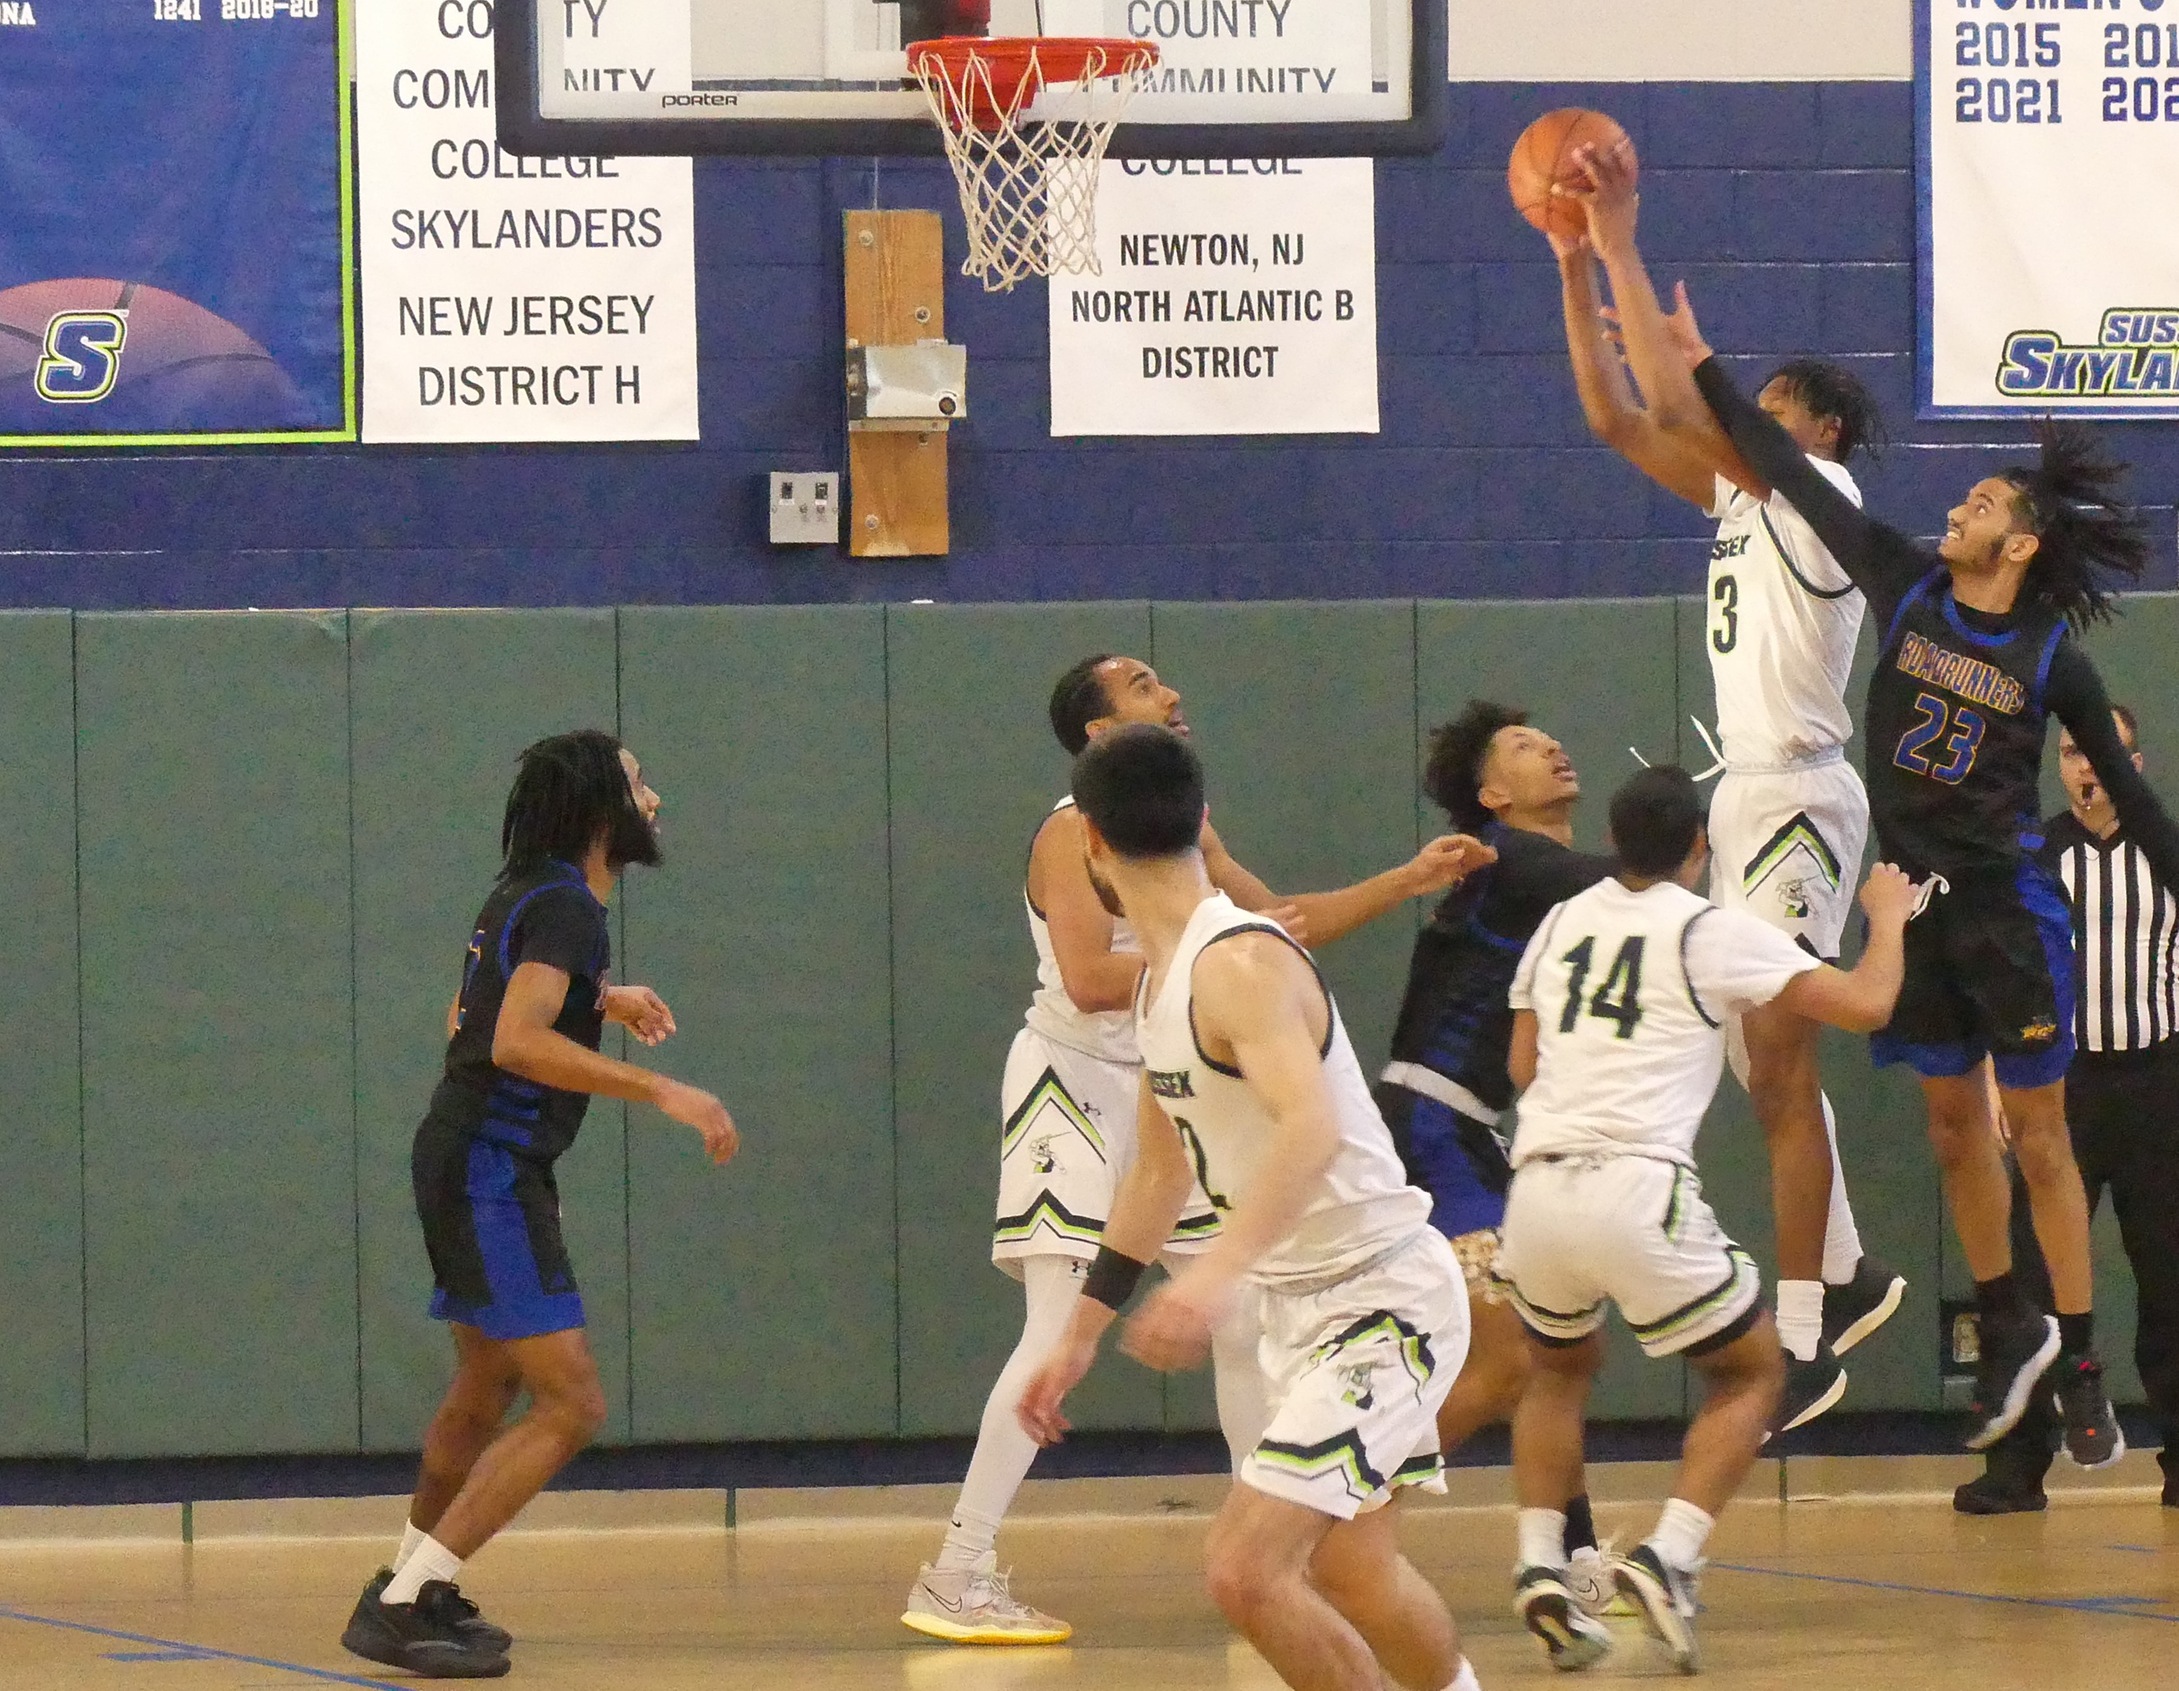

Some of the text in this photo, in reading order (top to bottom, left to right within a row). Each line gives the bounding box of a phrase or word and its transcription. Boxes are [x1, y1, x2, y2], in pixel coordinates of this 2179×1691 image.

[1127, 0, 1292, 39] COUNTY
[1955, 21, 2061, 68] 2015
[1955, 77, 2062, 124] 2021
[431, 138, 620, 179] COLLEGE
[391, 207, 663, 249] SKYLANDERS
[1120, 233, 1304, 272] NEWTON, NJ
[399, 295, 655, 337] NEW JERSEY
[1071, 289, 1354, 322] NORTH ATLANTIC B
[2105, 314, 2179, 343] SUS
[36, 310, 128, 403] S
[1142, 346, 1279, 379] DISTRICT
[2002, 336, 2179, 391] SKYLA
[419, 366, 641, 406] DISTRICT H
[1712, 574, 1738, 654] 3
[1896, 630, 2025, 715] ROADRUNNERS
[1892, 692, 1986, 785] 23
[1558, 935, 1646, 1039] 14
